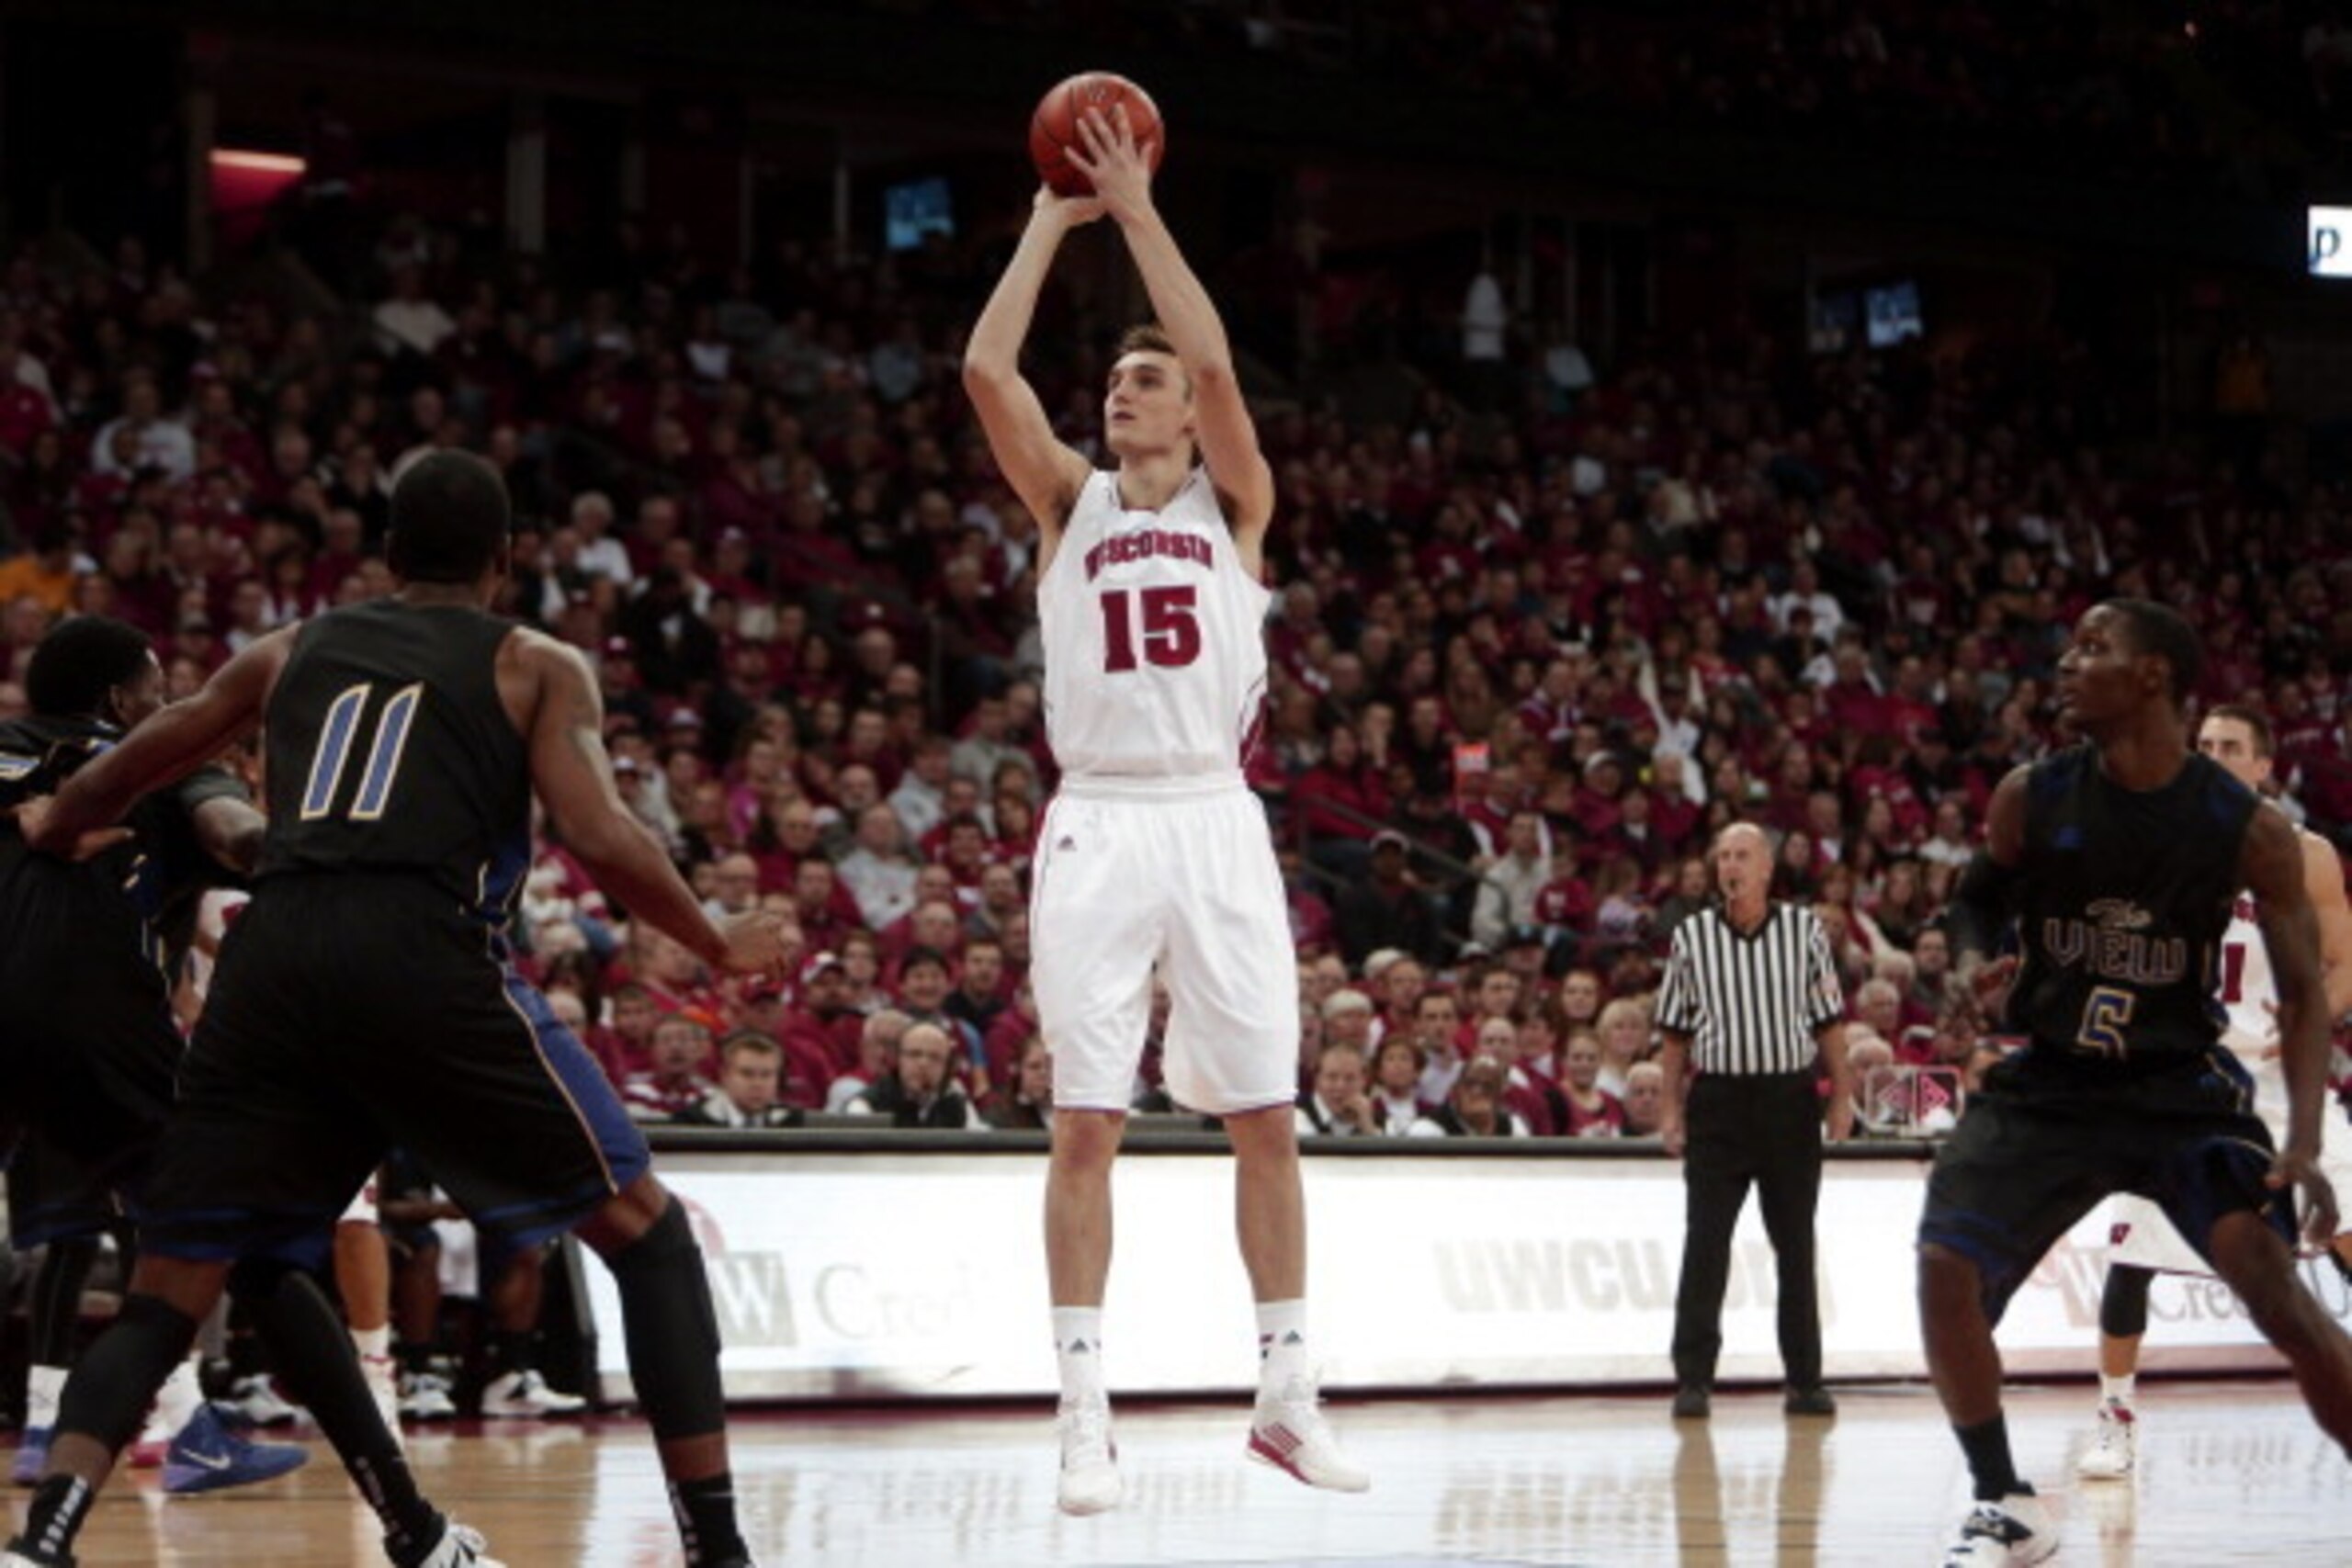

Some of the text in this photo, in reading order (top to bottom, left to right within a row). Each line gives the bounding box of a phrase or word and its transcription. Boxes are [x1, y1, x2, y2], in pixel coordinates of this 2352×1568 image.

[1085, 527, 1212, 583] WISCONSIN
[1101, 585, 1200, 673] 15
[300, 682, 424, 820] 11
